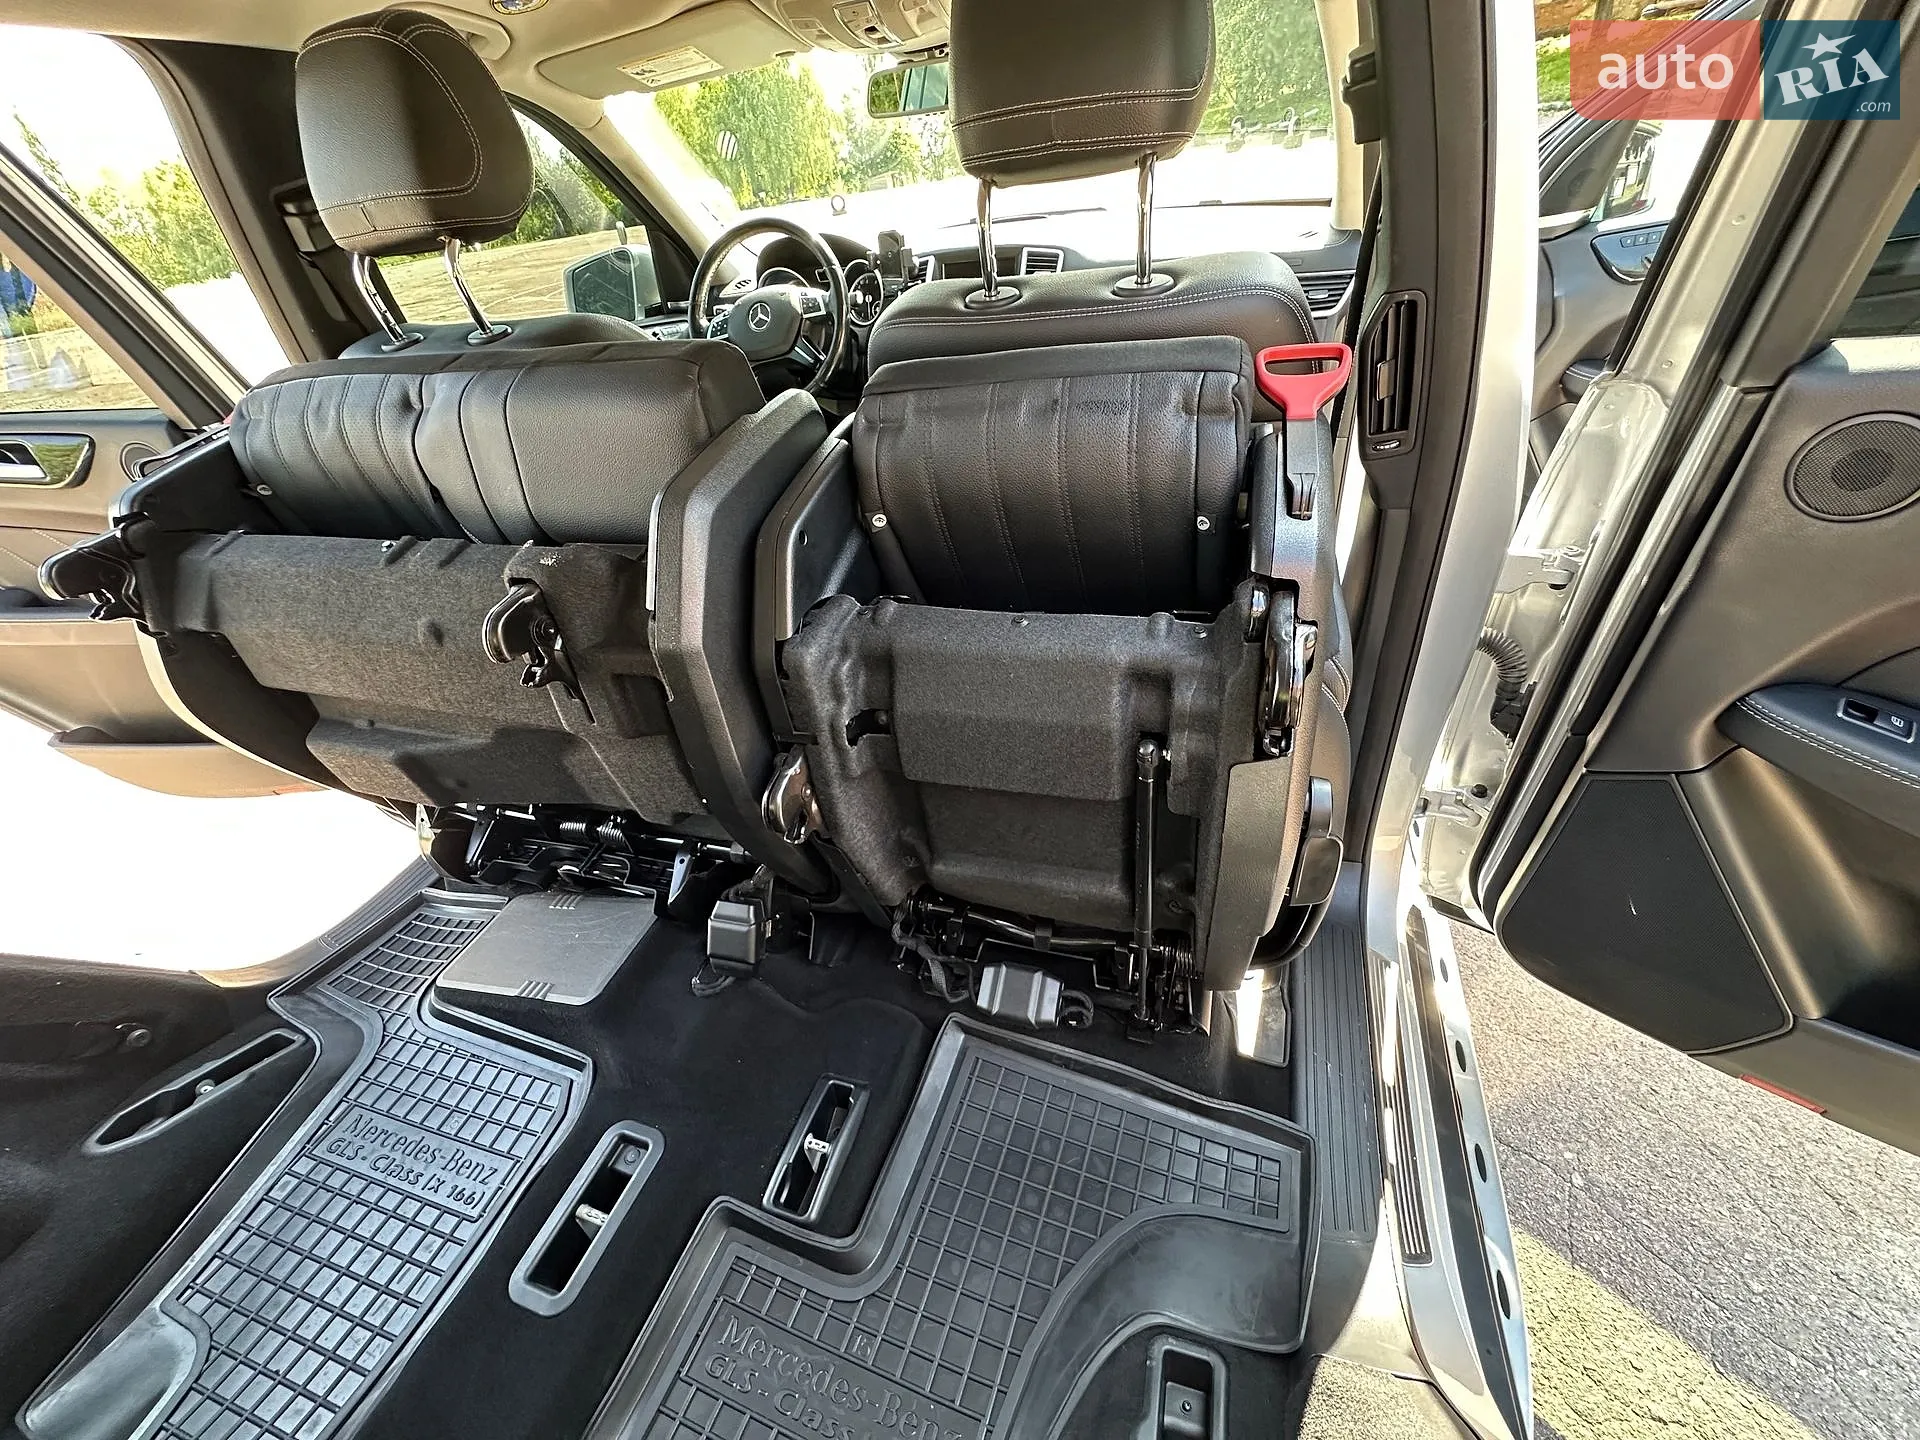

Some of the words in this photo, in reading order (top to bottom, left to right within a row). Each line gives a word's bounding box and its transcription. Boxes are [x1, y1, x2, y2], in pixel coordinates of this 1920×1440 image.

[326, 1137, 365, 1161] GLS
[369, 1153, 424, 1186] Class
[342, 1113, 498, 1186] Mercedes-Benz
[704, 1352, 759, 1394] GLS
